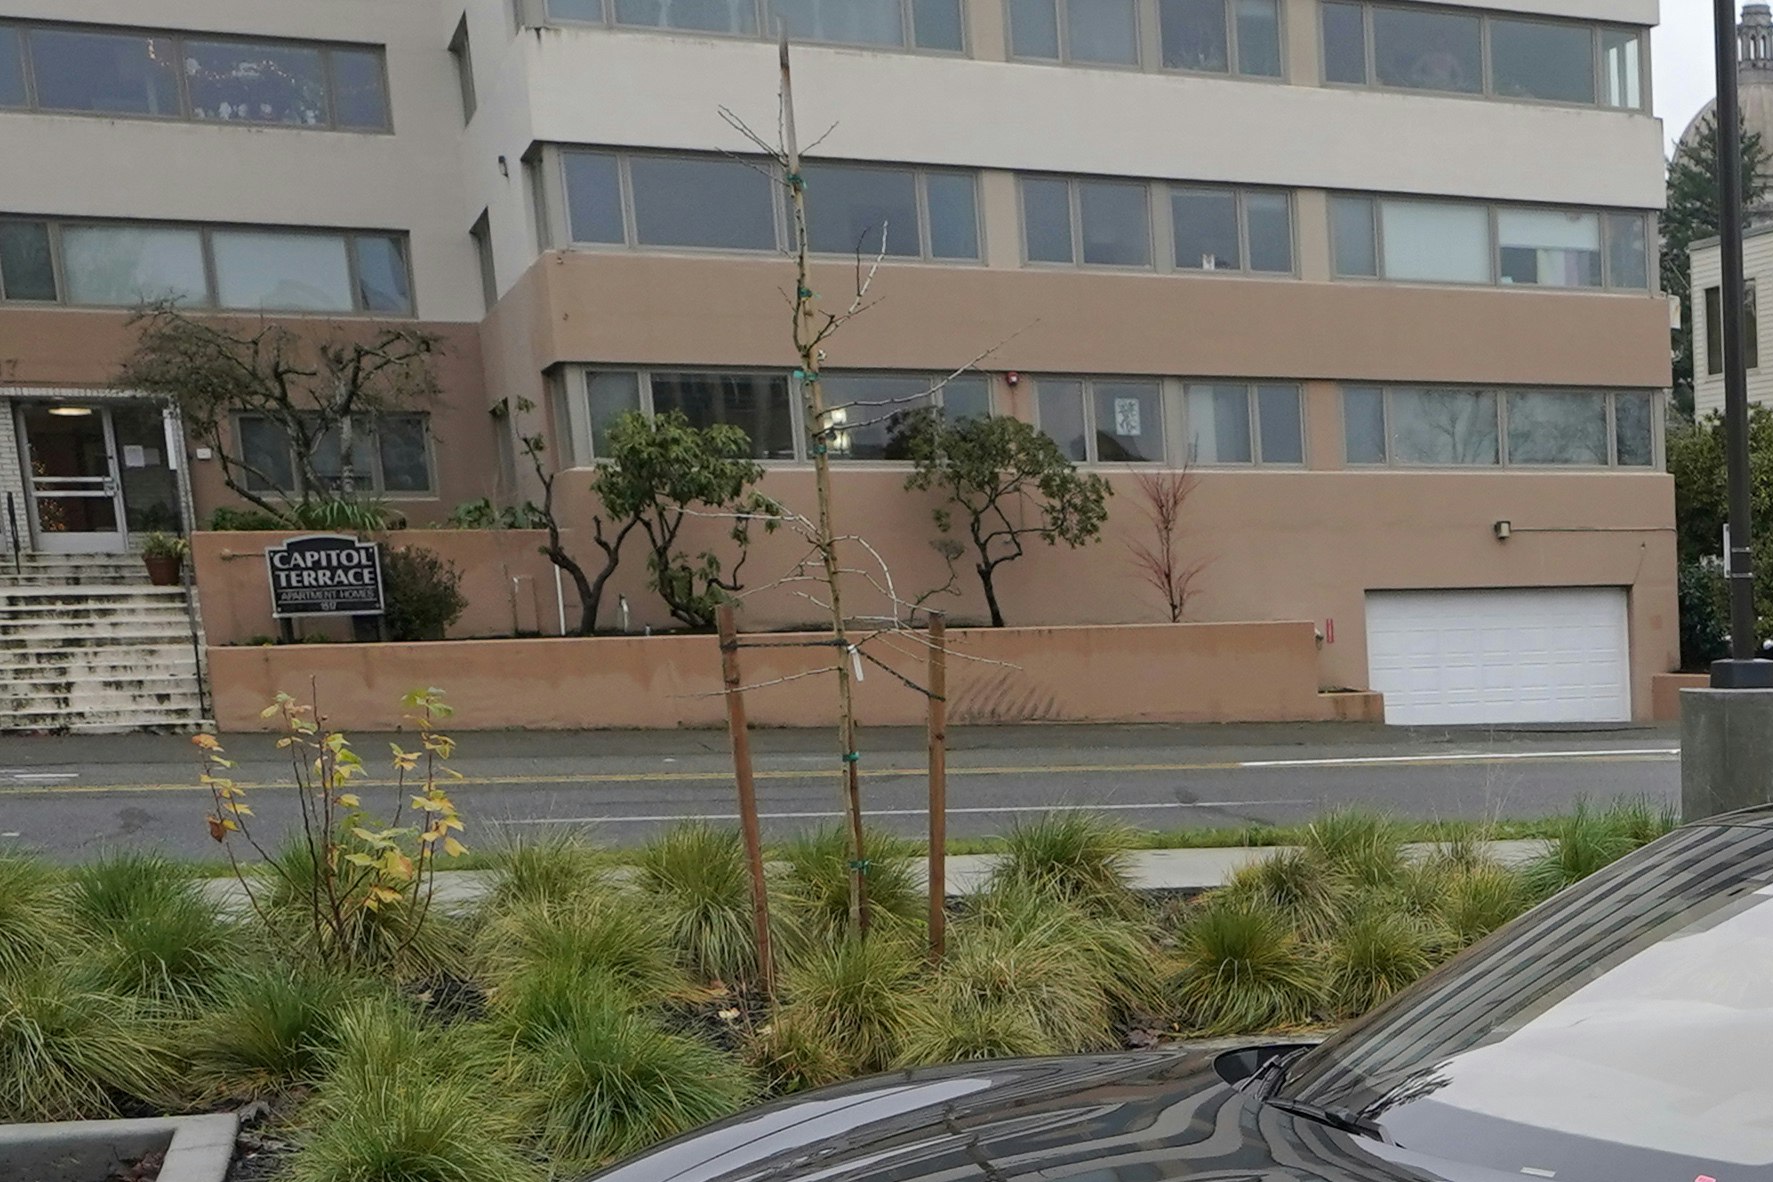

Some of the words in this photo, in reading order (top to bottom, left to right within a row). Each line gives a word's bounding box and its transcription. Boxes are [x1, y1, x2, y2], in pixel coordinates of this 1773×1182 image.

[273, 548, 373, 569] CAPITOL
[275, 567, 376, 588] TERRACE
[281, 590, 337, 601] APARTMENT
[340, 589, 375, 599] HOMES
